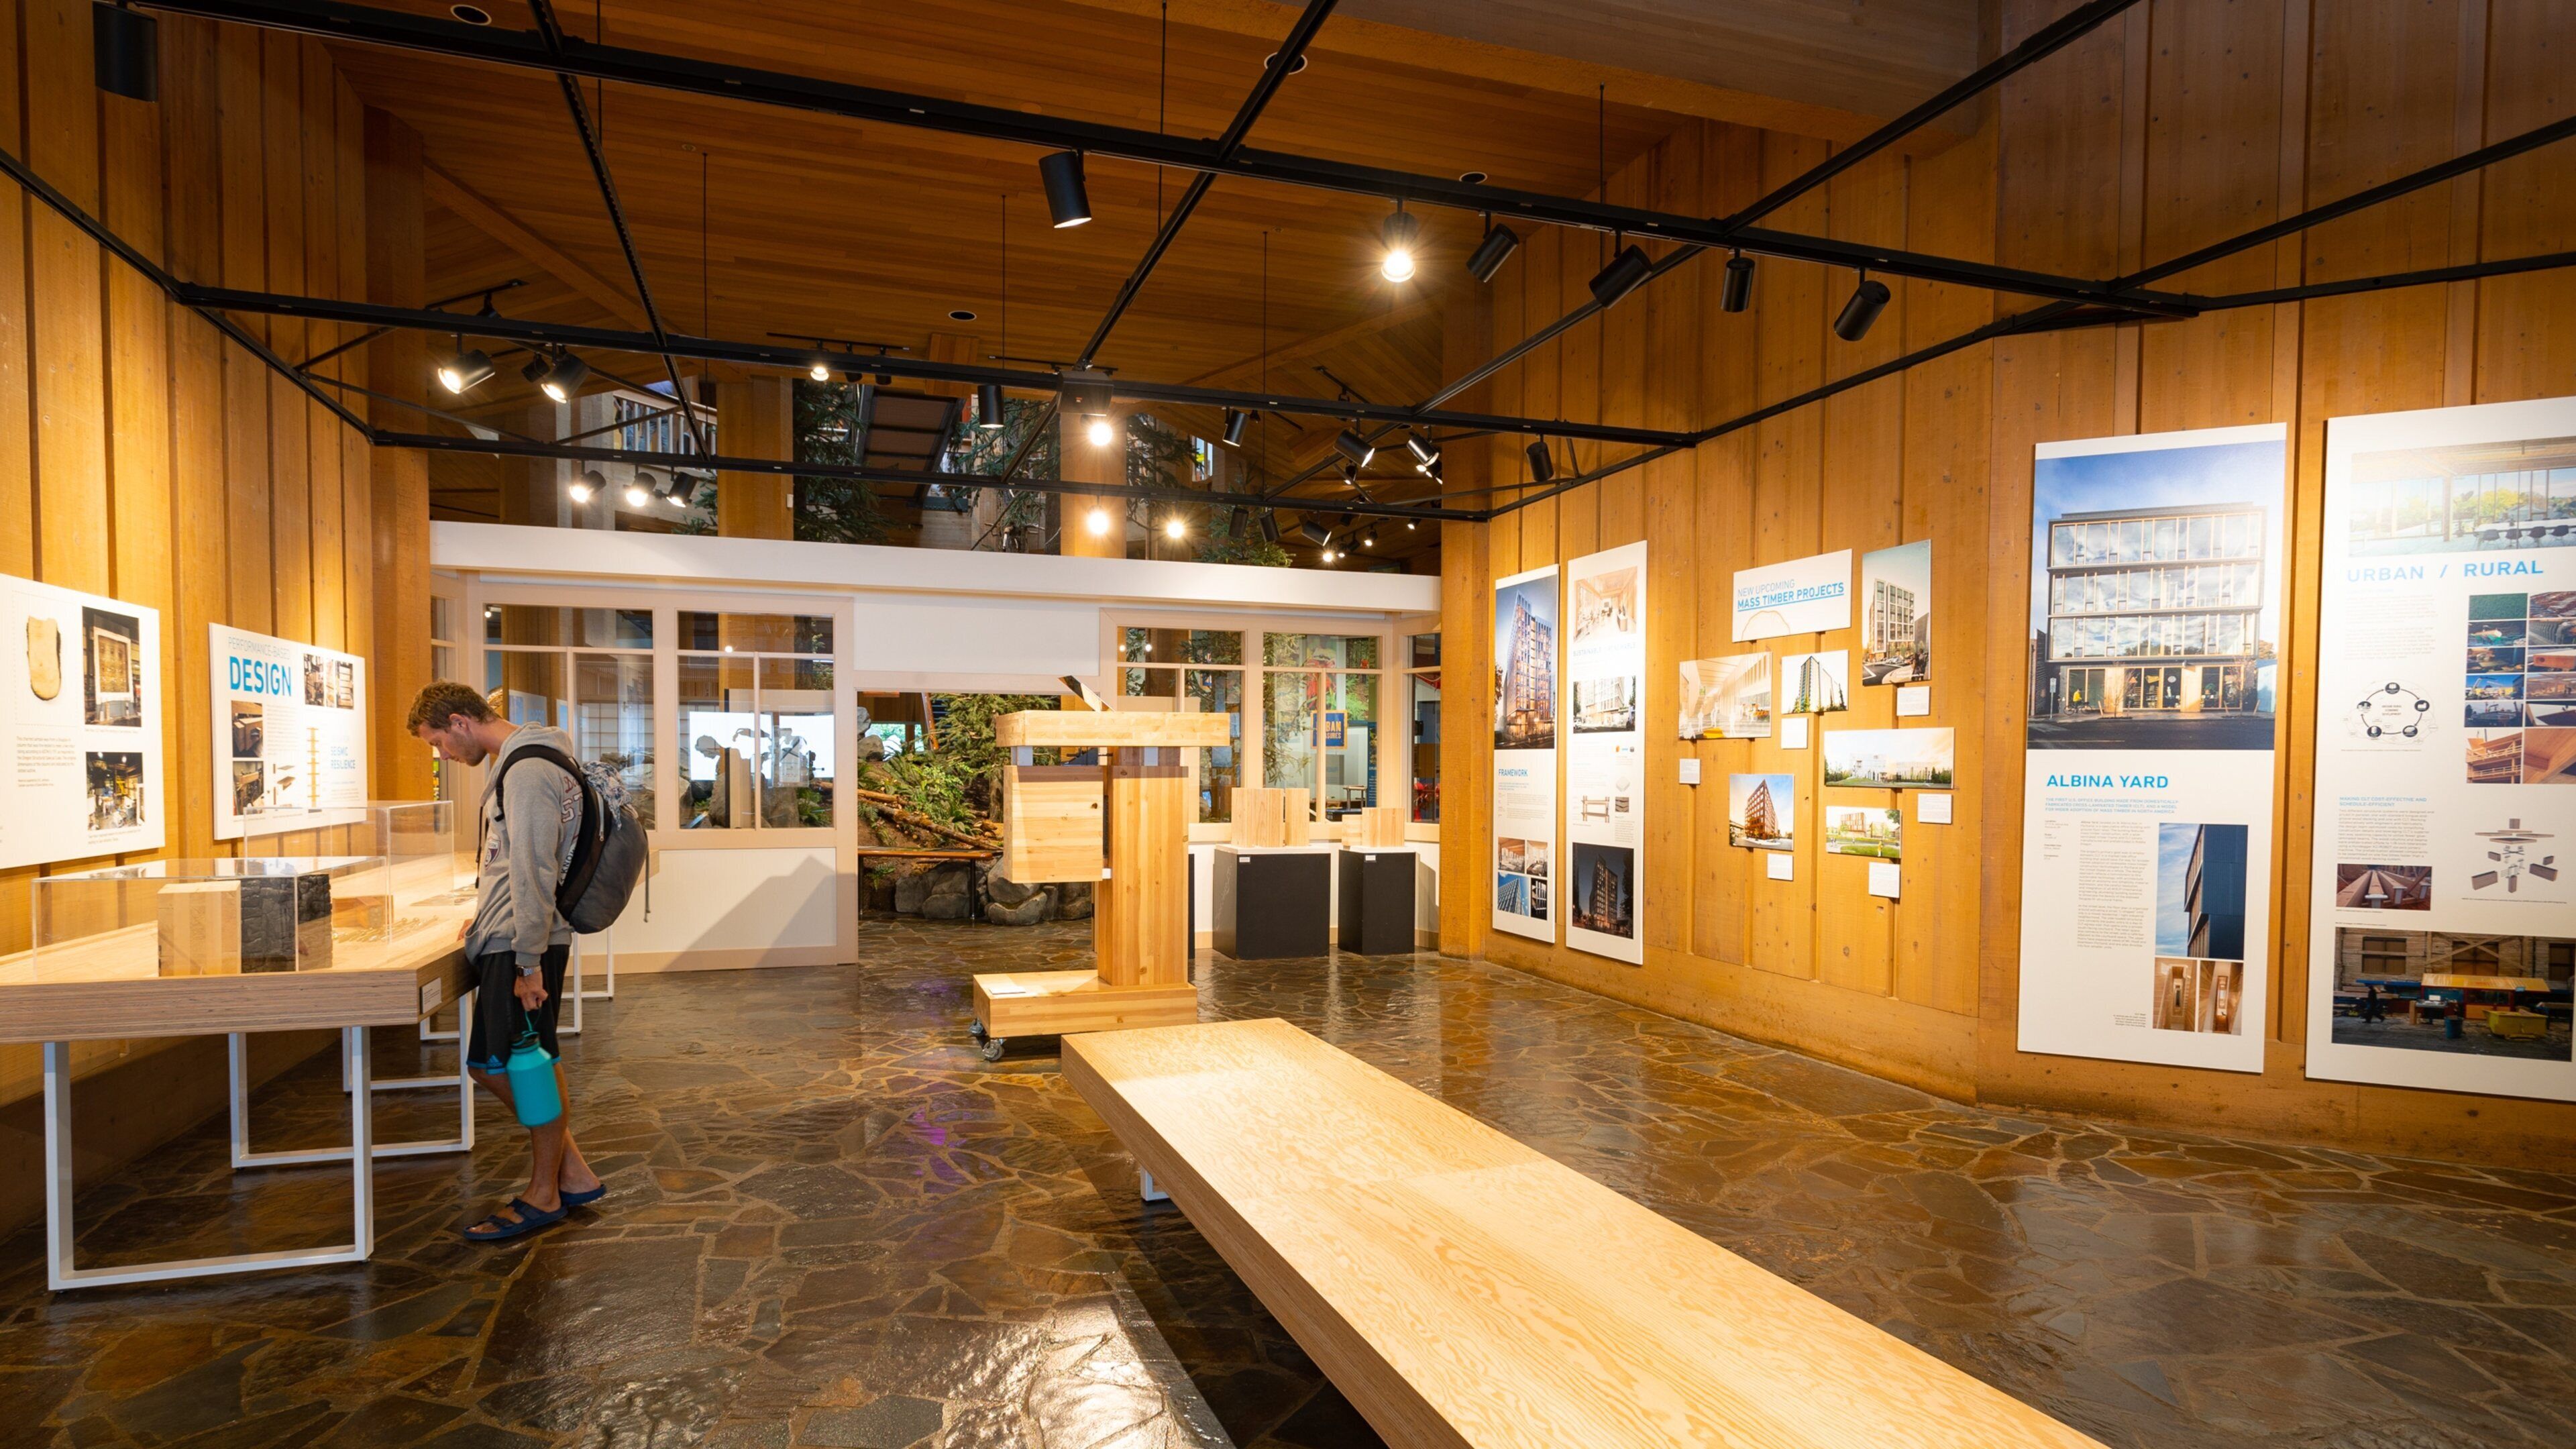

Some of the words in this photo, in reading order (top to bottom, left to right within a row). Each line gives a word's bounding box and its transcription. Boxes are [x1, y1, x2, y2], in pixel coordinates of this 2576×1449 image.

[2347, 566, 2424, 582] URBAN
[2463, 560, 2544, 577] RURAL
[1737, 597, 1760, 610] MASS
[1762, 590, 1795, 605] TIMBER
[1796, 582, 1845, 599] PROJECTS
[1738, 587, 1755, 597] NEW
[1756, 579, 1796, 595] UPCOMING
[229, 655, 292, 697] DESIGN
[1326, 721, 1342, 732] BAN
[2047, 775, 2114, 787] ALBINA
[2120, 775, 2168, 788] YARD
